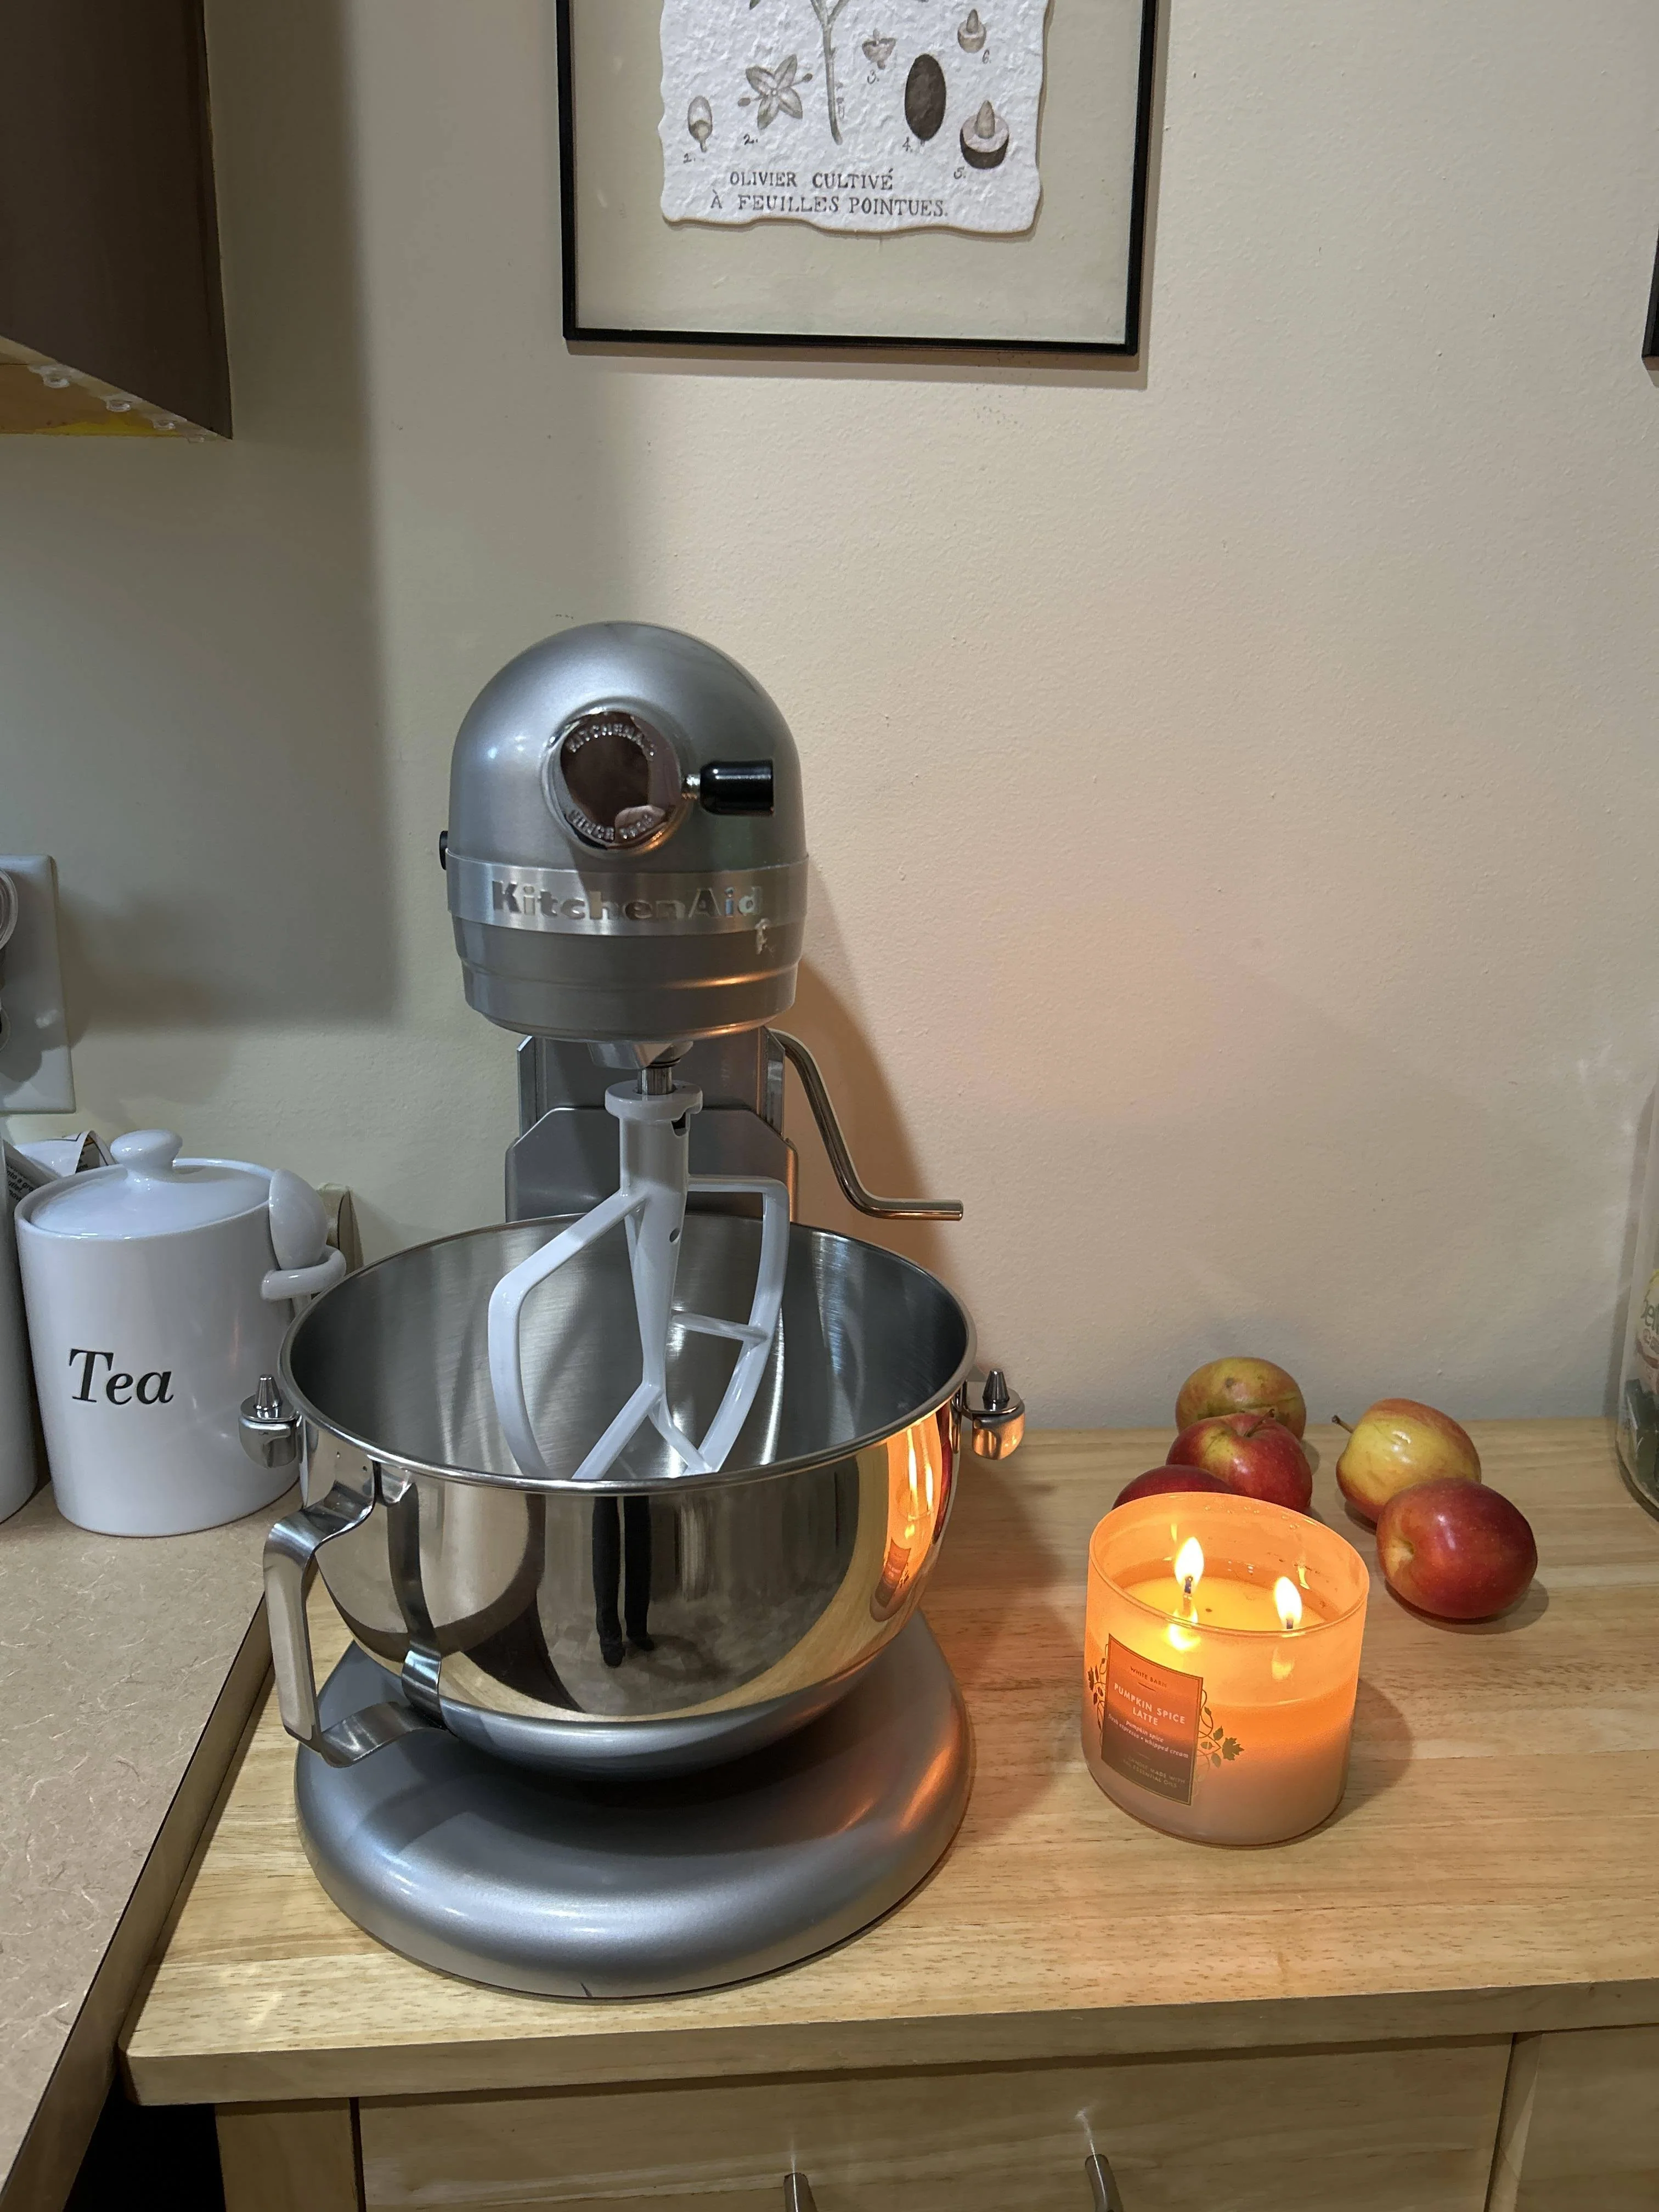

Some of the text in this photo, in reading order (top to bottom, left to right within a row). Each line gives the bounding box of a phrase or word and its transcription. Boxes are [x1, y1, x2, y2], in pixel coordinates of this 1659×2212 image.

[743, 133, 758, 145] 2.
[730, 168, 894, 190] OLIVIER CULTIVÉ
[710, 190, 948, 217] À FEUILLES POINTUES.
[492, 880, 763, 921] KitchenAid
[69, 1348, 174, 1406] Tea
[1130, 1665, 1168, 1689] WHITE BARN
[1114, 1682, 1186, 1724] PUMPKIN SPICE
[1132, 1707, 1159, 1726] LATTE
[1119, 1723, 1139, 1739] espresso
[1144, 1739, 1169, 1752] whipped
[1170, 1749, 1189, 1759] cream
[1126, 1720, 1164, 1743] pumpkin spice
